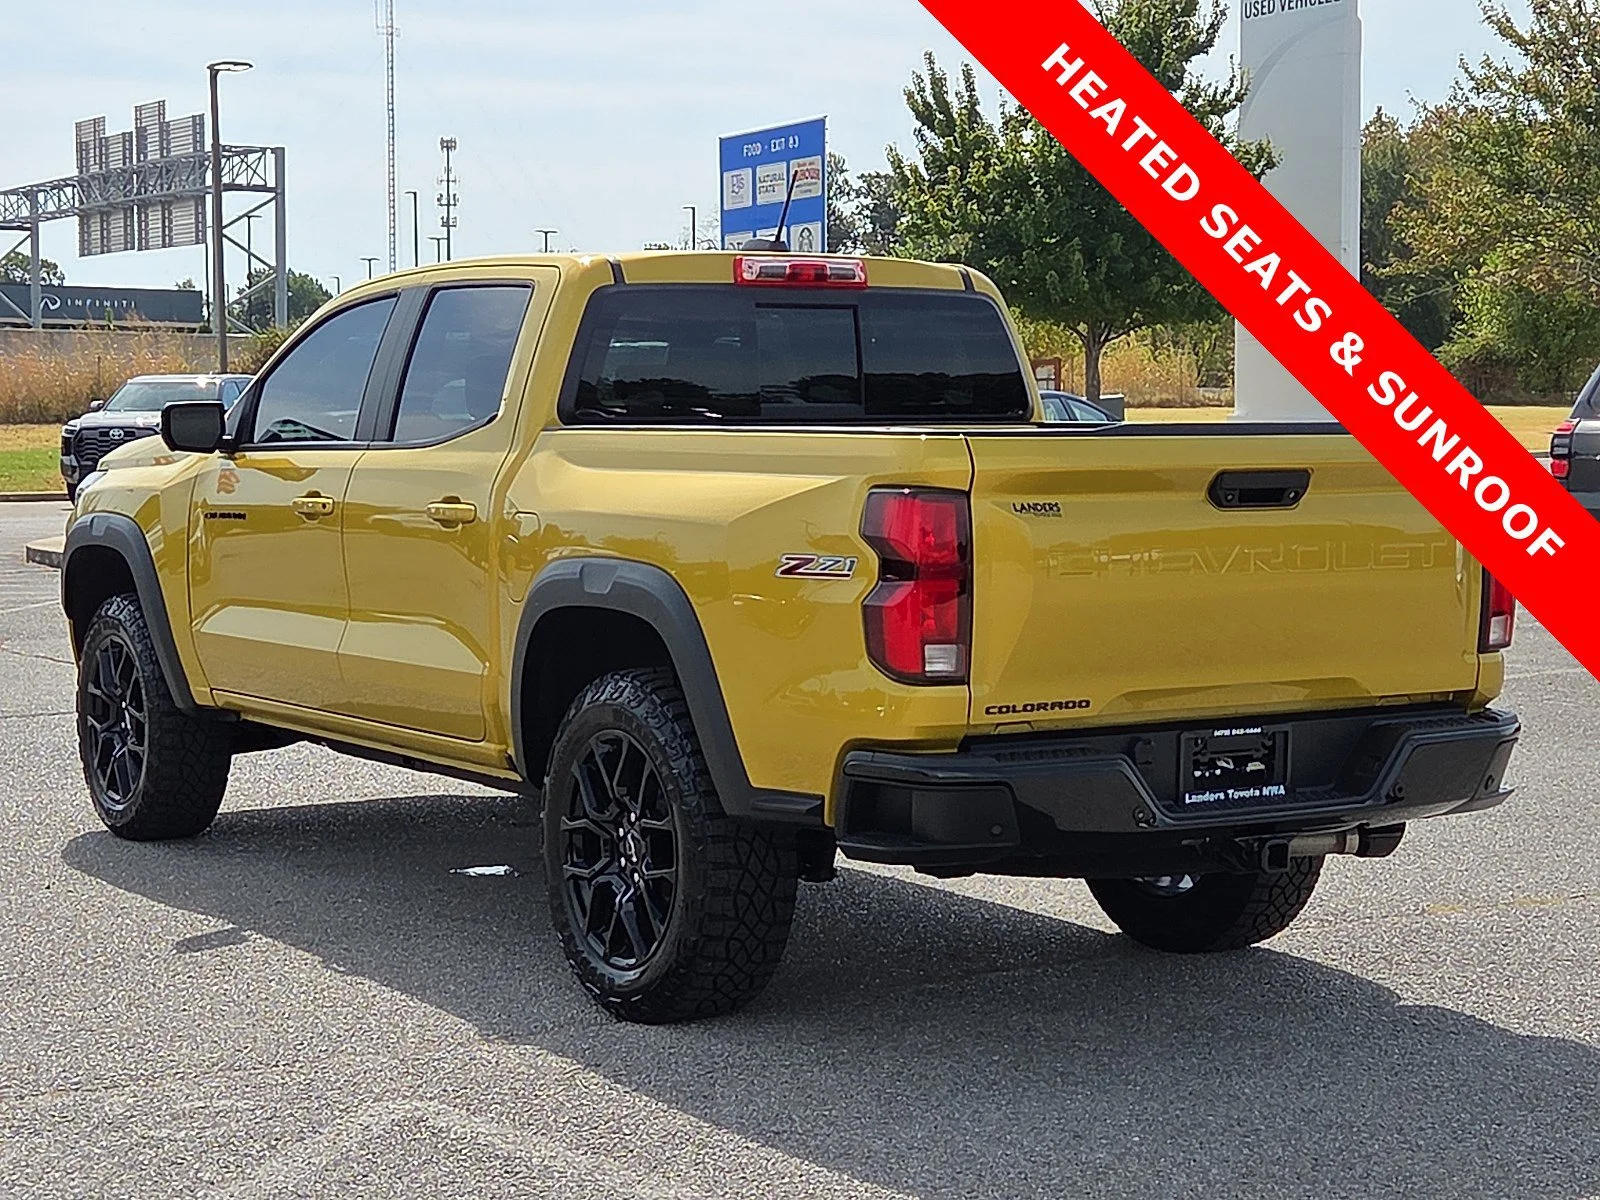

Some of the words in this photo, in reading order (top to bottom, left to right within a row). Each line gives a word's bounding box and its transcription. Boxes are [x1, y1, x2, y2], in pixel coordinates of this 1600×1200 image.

[1244, 0, 1276, 19] USED
[1280, 0, 1341, 12] VEHI
[743, 142, 762, 157] FOOD
[771, 138, 786, 152] EXIT
[66, 298, 136, 309] INFINITI
[1012, 502, 1061, 513] LANDERS
[775, 554, 858, 580] Z71
[1050, 540, 1447, 577] CHEVROLET
[984, 700, 1091, 715] COLORADO
[1185, 790, 1225, 804] Landers
[1227, 787, 1260, 799] Toyota
[1262, 785, 1286, 797] NWA
